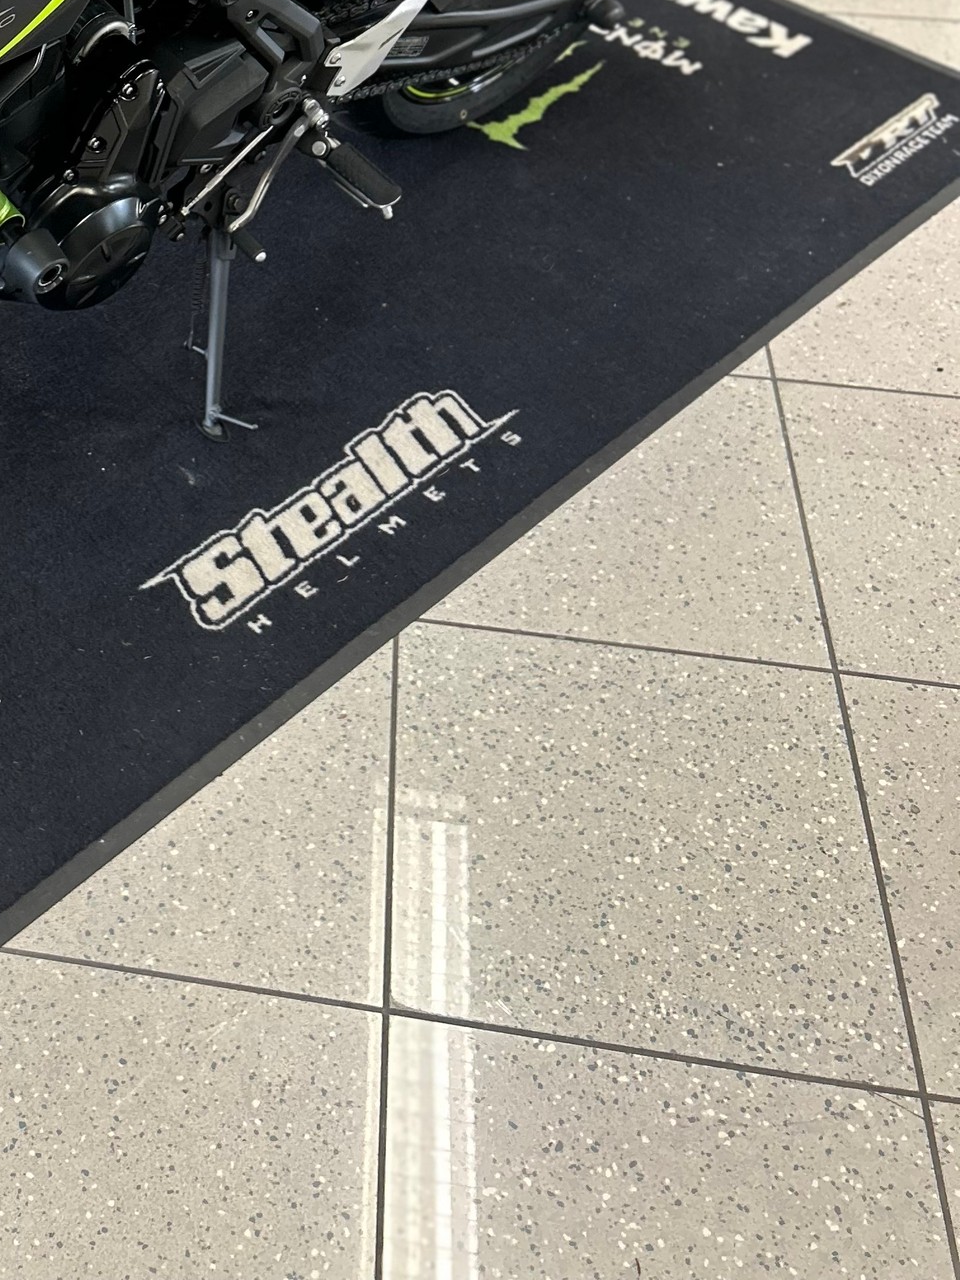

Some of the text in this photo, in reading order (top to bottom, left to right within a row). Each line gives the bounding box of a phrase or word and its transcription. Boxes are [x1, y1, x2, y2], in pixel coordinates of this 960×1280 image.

[860, 113, 960, 186] DIXON RACE TEAM
[178, 390, 485, 628] Stealth
[246, 430, 522, 635] HELMETS
